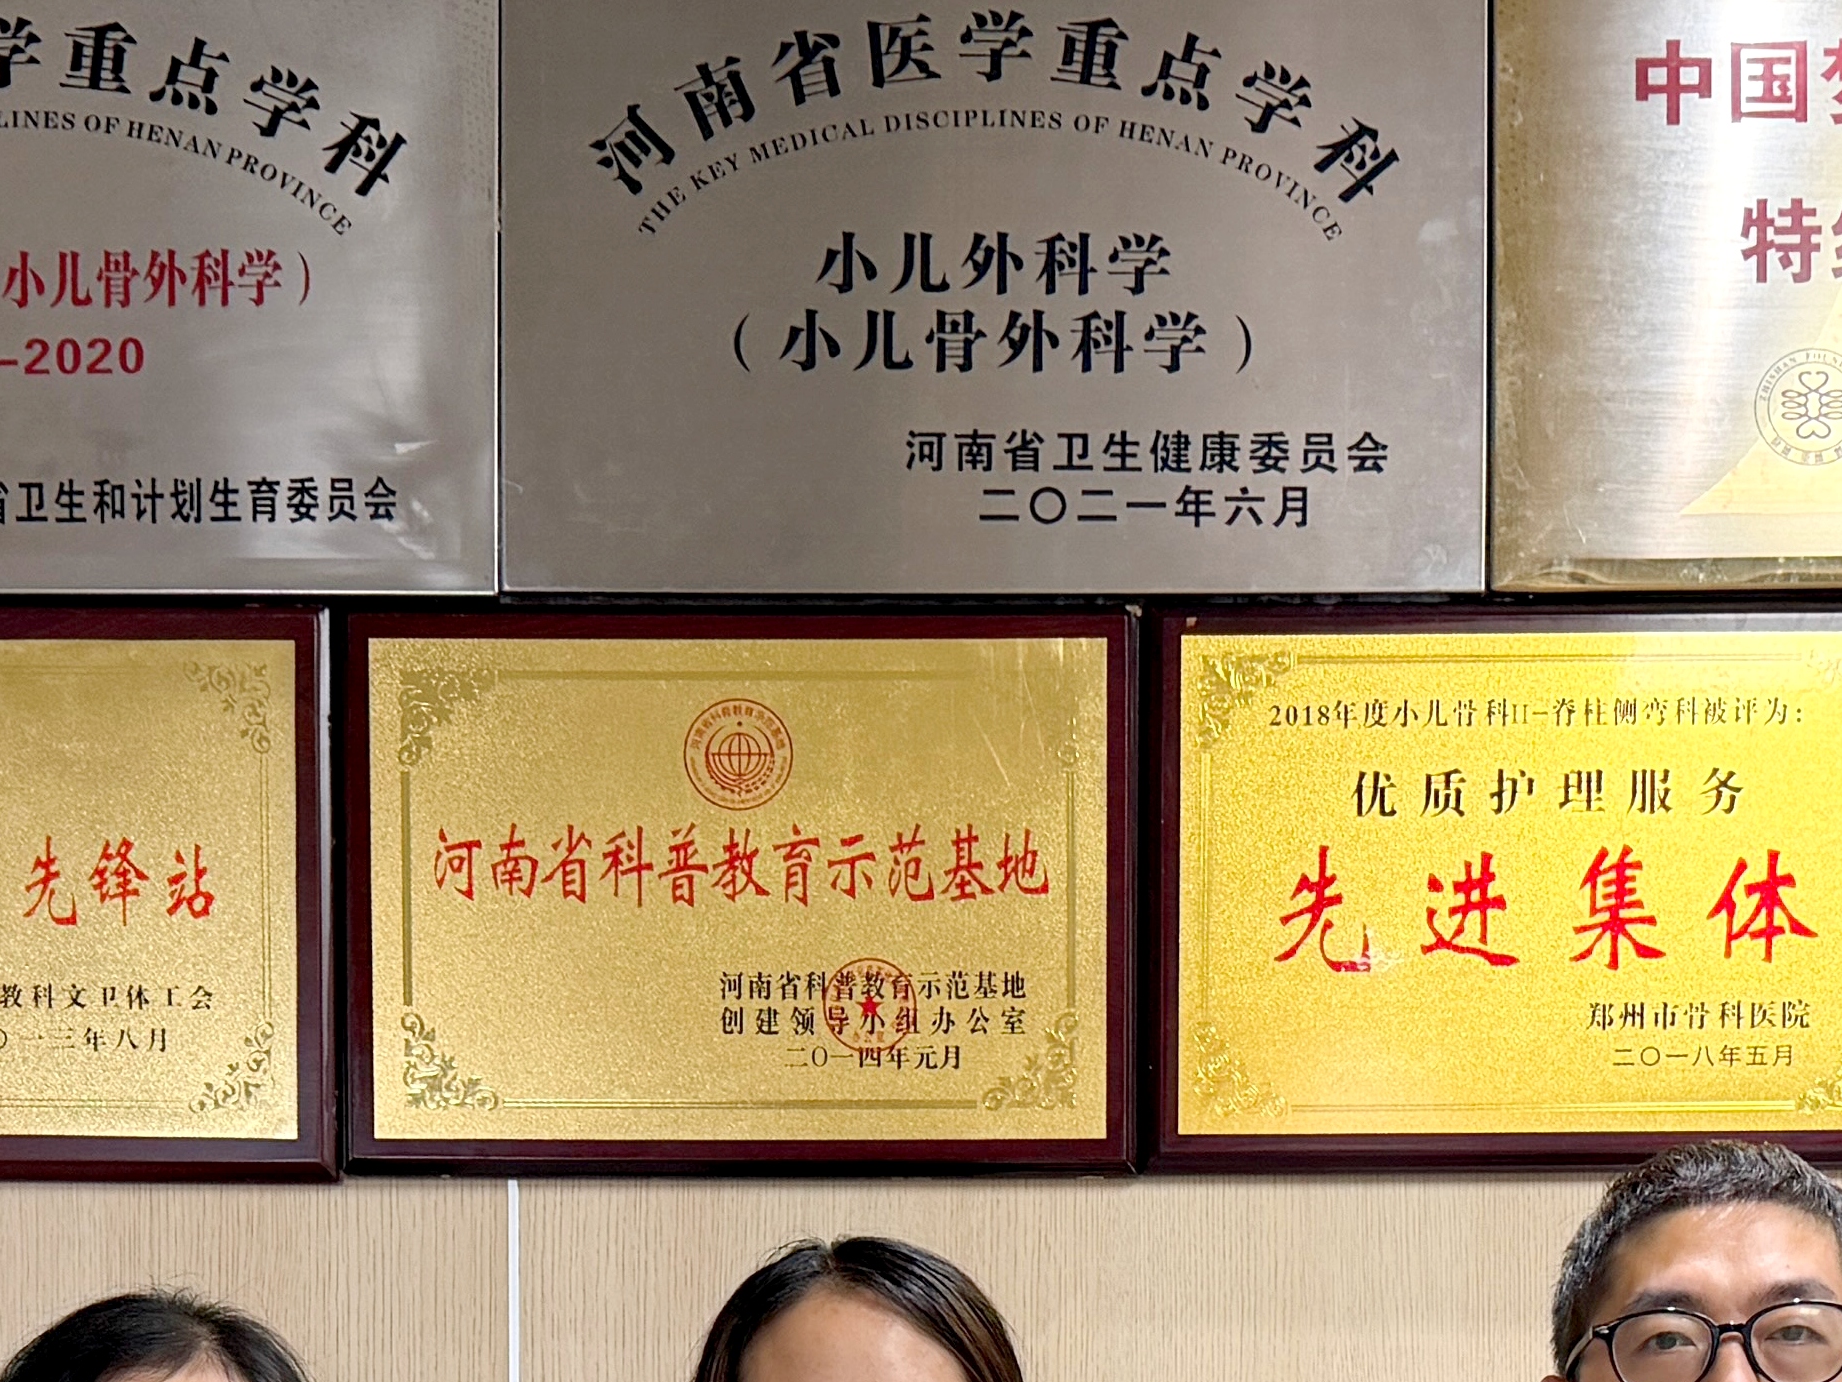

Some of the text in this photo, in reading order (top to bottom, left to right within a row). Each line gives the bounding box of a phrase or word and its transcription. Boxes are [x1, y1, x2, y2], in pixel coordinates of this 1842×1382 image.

[589, 10, 1400, 203] 河南省医学重点学科
[83, 115, 120, 135] OF
[127, 119, 222, 160] HENAN
[225, 146, 352, 236] PROVINCE
[638, 109, 1343, 241] THE KEY MEDICAL DISCIPLINES OF HENAN PROVINCE
[816, 231, 1172, 296] 小儿外科学
[904, 429, 1390, 475] 河南省卫生健康委员会
[1350, 767, 1745, 818] 优质护理服务
[433, 822, 1050, 909] 河南省科普教育示范基地
[1274, 844, 1819, 973] 先进集体
[719, 971, 1027, 1001] 河南省科普教育示范基地
[1587, 999, 1812, 1032] 郑州市骨科医院
[720, 1005, 1027, 1036] 创建领导小组办公室
